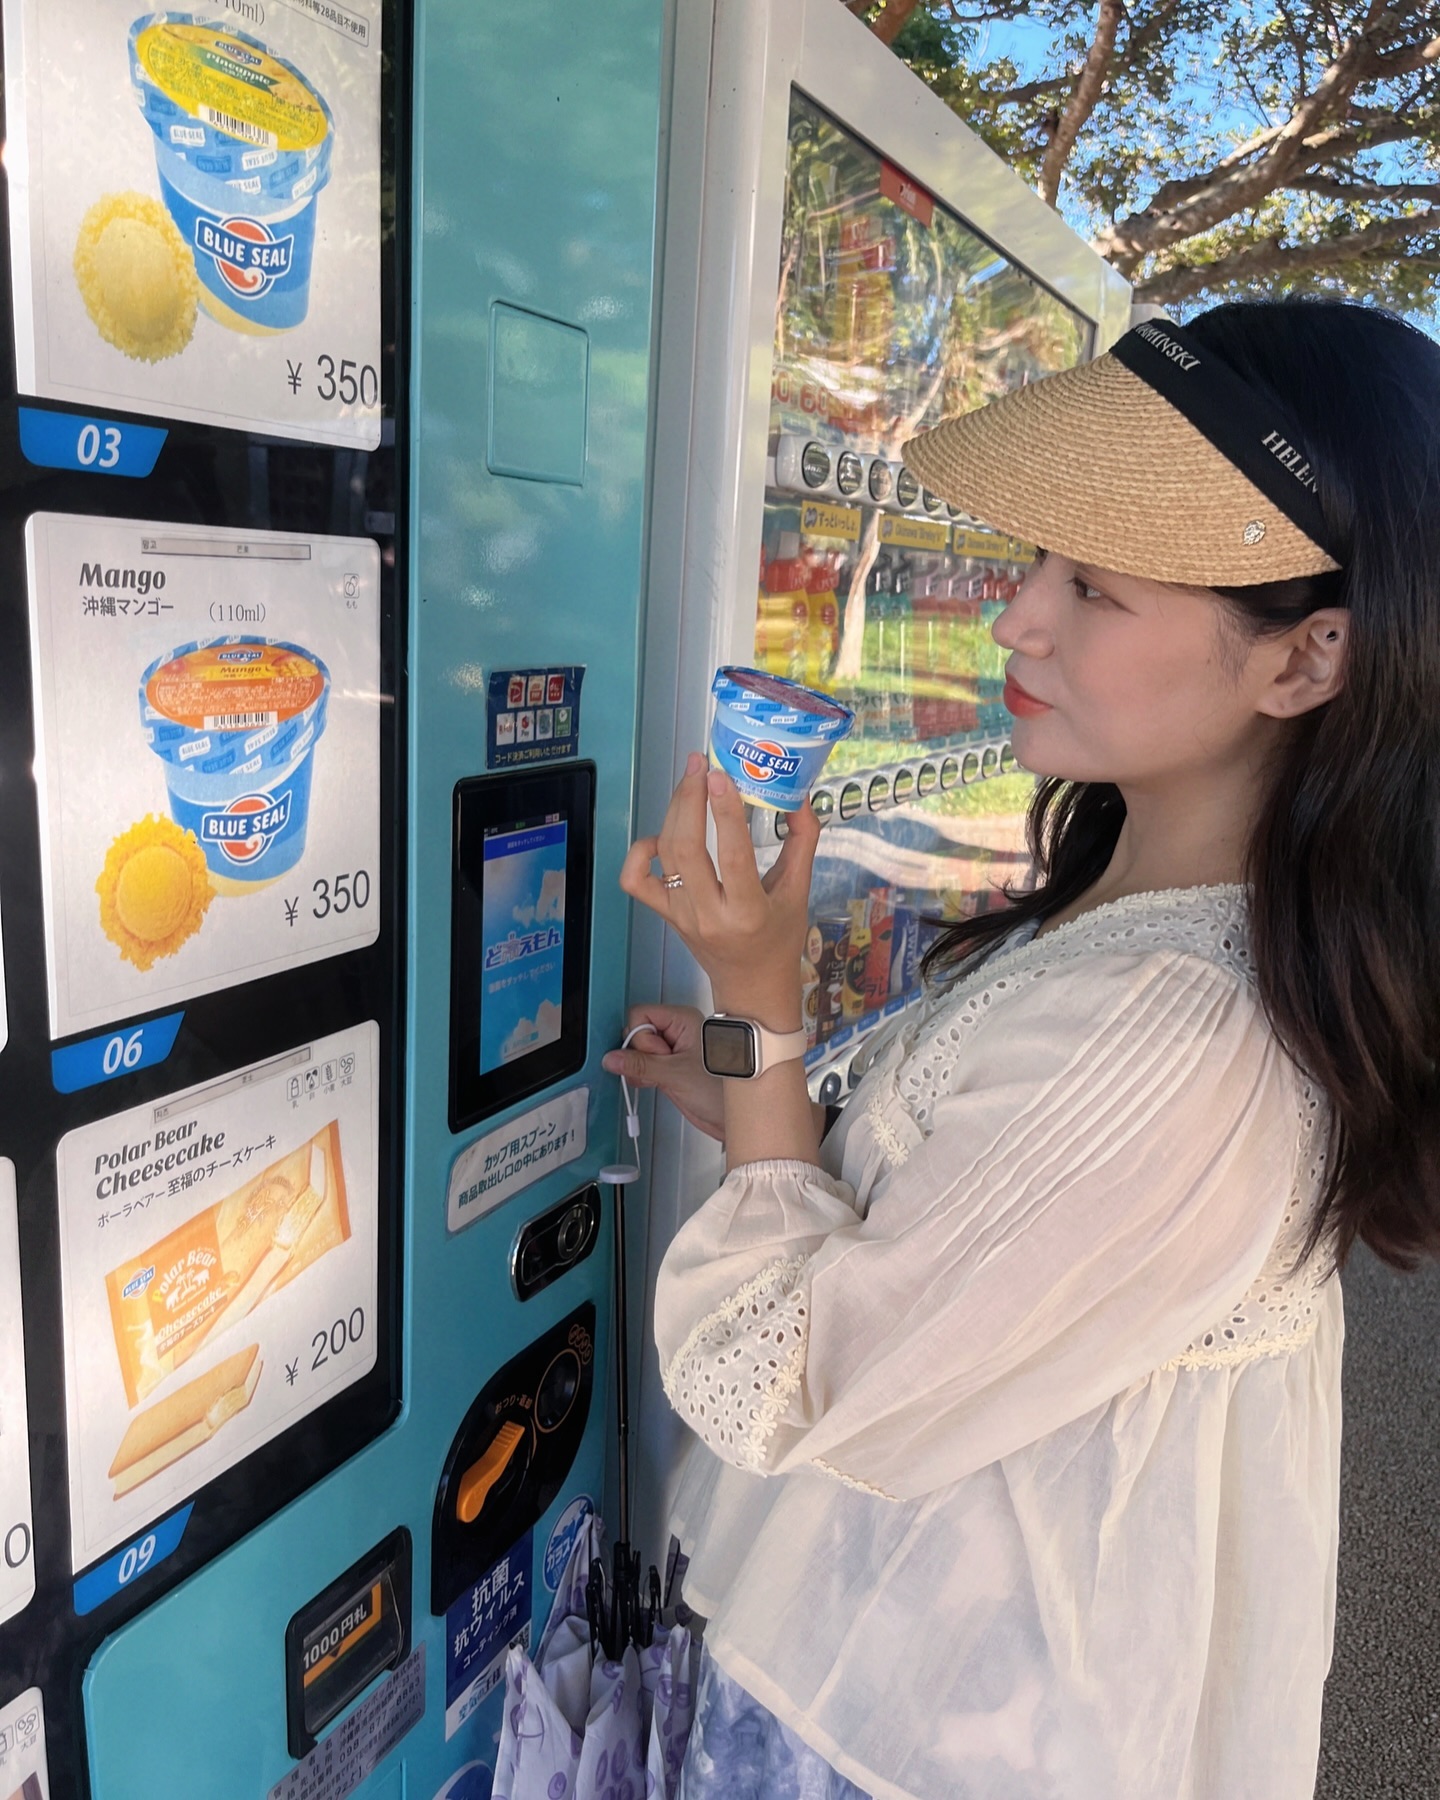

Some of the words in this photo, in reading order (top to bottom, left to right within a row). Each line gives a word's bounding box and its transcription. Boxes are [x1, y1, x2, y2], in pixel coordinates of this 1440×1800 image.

[206, 52, 271, 85] Pineapple
[203, 226, 247, 264] BLUE
[250, 244, 288, 268] SEAL
[286, 358, 303, 395] ¥
[316, 353, 379, 410] 350
[76, 423, 123, 469] 03
[79, 562, 167, 595] Mango
[82, 595, 175, 617] 沖縄マンゴー
[208, 601, 267, 623] (110ml)
[220, 665, 262, 675] Mango
[242, 652, 261, 660] SEAL
[737, 743, 767, 765] BLUE
[766, 756, 796, 773] SEAL
[208, 817, 248, 837] BLUE
[252, 804, 286, 833] SEAL
[283, 895, 299, 927] ¥
[311, 869, 371, 920] 350
[102, 1029, 144, 1076] 06
[94, 1139, 152, 1176] Polar
[154, 1120, 199, 1152] Bear
[96, 1131, 226, 1200] Cheesecake
[484, 1122, 557, 1174] カップ用スプーン
[124, 1280, 140, 1297] BLUE
[140, 1267, 155, 1284] SEAL
[151, 1259, 185, 1304] Polar
[186, 1248, 217, 1267] Bear
[157, 1286, 223, 1339] Cheesecake
[284, 1357, 299, 1386] ¥
[310, 1306, 366, 1371] 200
[0, 1522, 31, 1568] 0
[117, 1534, 157, 1585] 09
[472, 1556, 511, 1618] 抗菌
[303, 1603, 367, 1670] 1000円札
[454, 1570, 525, 1659] 抗ウィルス
